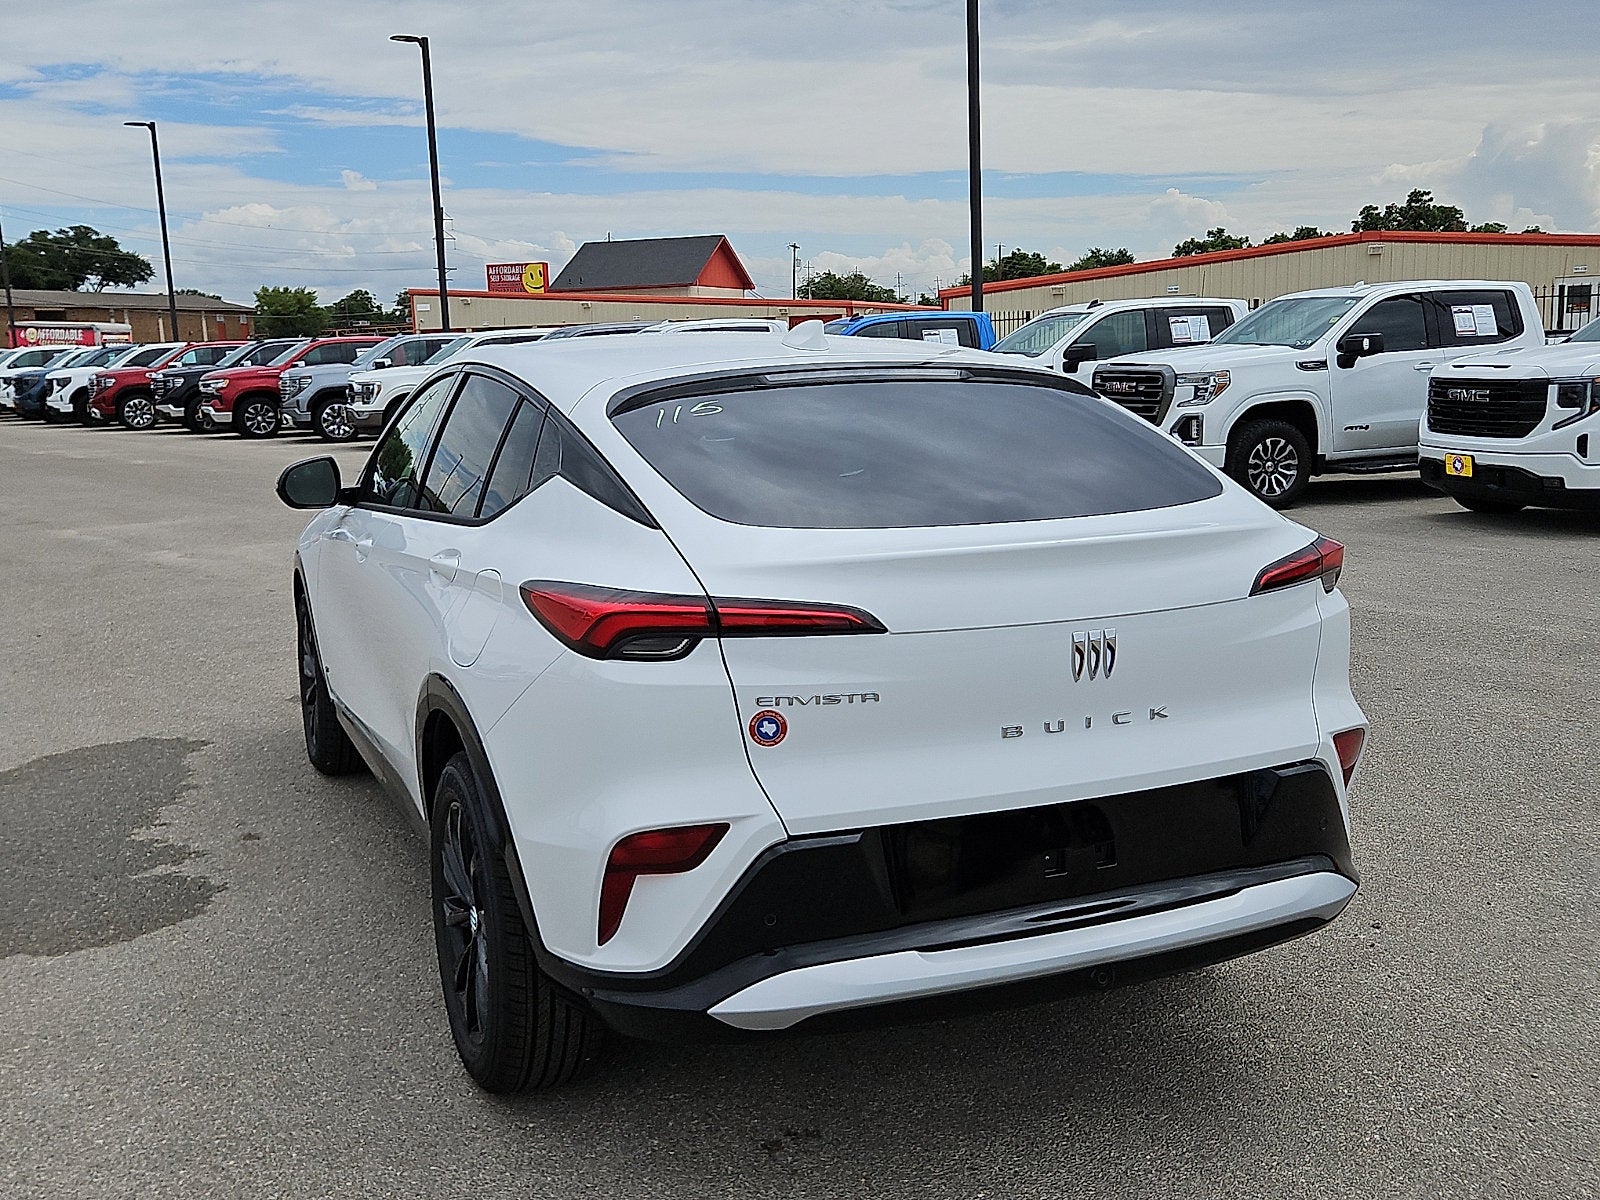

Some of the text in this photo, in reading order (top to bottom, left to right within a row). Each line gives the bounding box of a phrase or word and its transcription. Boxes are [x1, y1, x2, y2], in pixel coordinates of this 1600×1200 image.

[488, 265, 527, 275] AFFORDABLE
[500, 274, 521, 282] STORAGE
[37, 328, 84, 341] AFFORDABLE
[1447, 388, 1490, 402] GMC
[656, 400, 723, 428] 115
[755, 692, 880, 707] ENVISTA
[1001, 705, 1169, 739] BUICK
